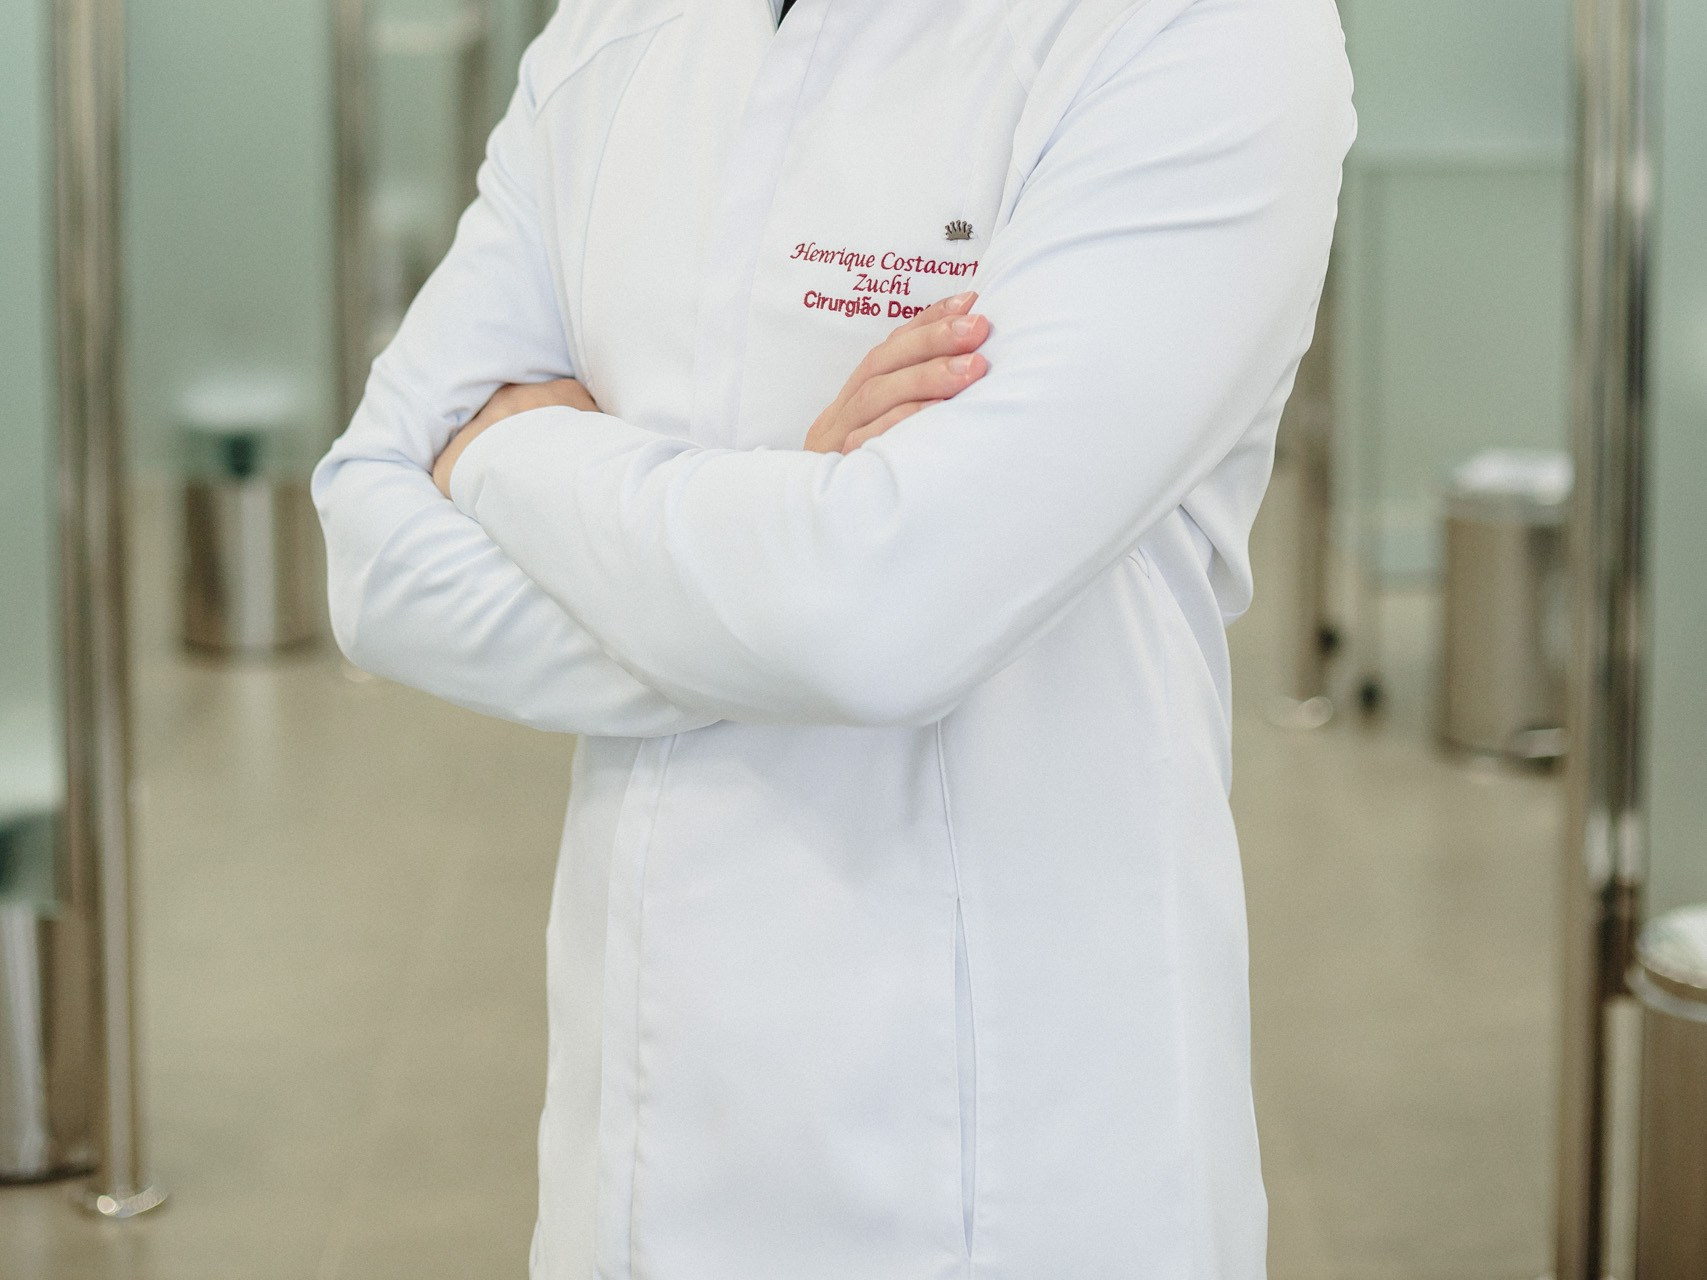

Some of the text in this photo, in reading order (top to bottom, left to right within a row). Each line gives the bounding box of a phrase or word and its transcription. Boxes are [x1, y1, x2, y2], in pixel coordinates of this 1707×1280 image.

[789, 241, 876, 272] Henrique
[852, 273, 911, 295] Zuchi
[803, 289, 881, 318] Cirurgião
